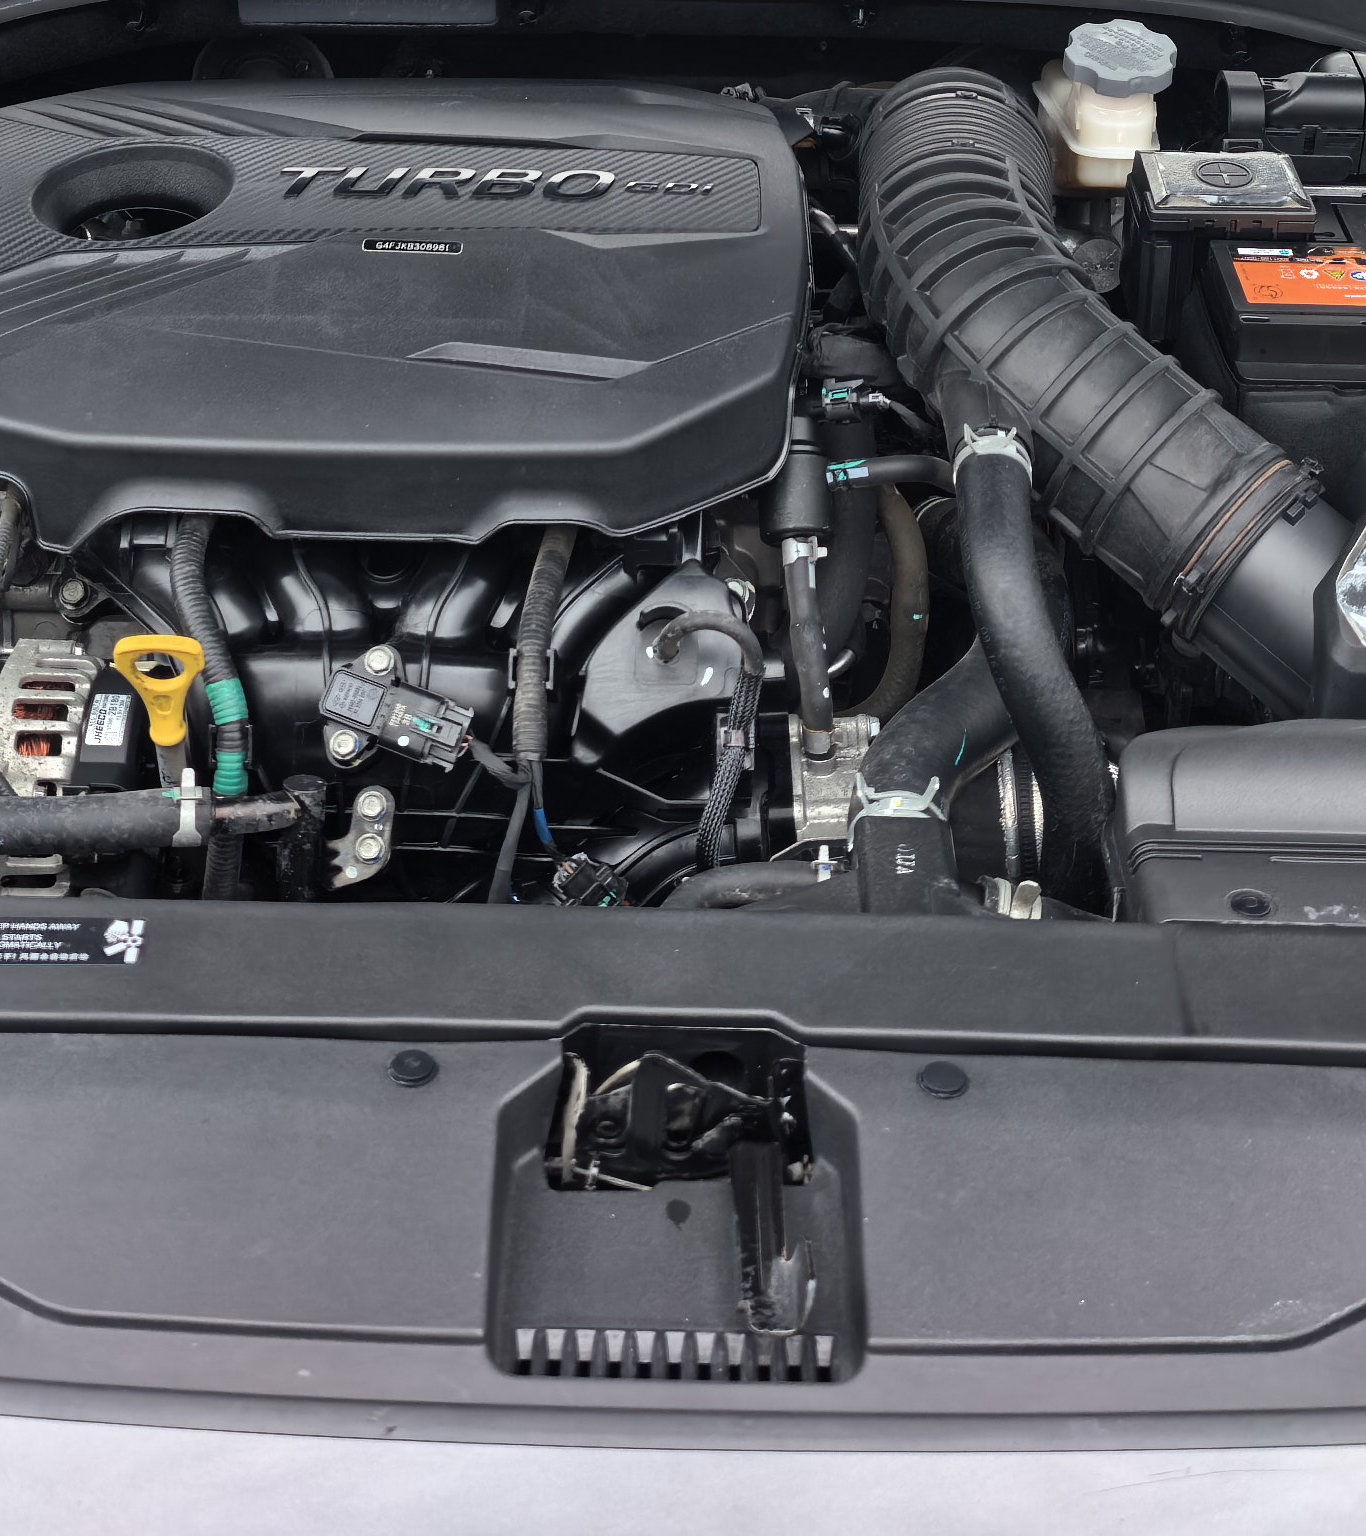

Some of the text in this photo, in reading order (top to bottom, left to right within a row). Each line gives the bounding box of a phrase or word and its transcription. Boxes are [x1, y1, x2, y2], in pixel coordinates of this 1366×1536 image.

[281, 166, 616, 201] TURBO
[10, 922, 48, 931] HANDS
[48, 923, 81, 931] AWAY
[2, 933, 43, 941] STARTS
